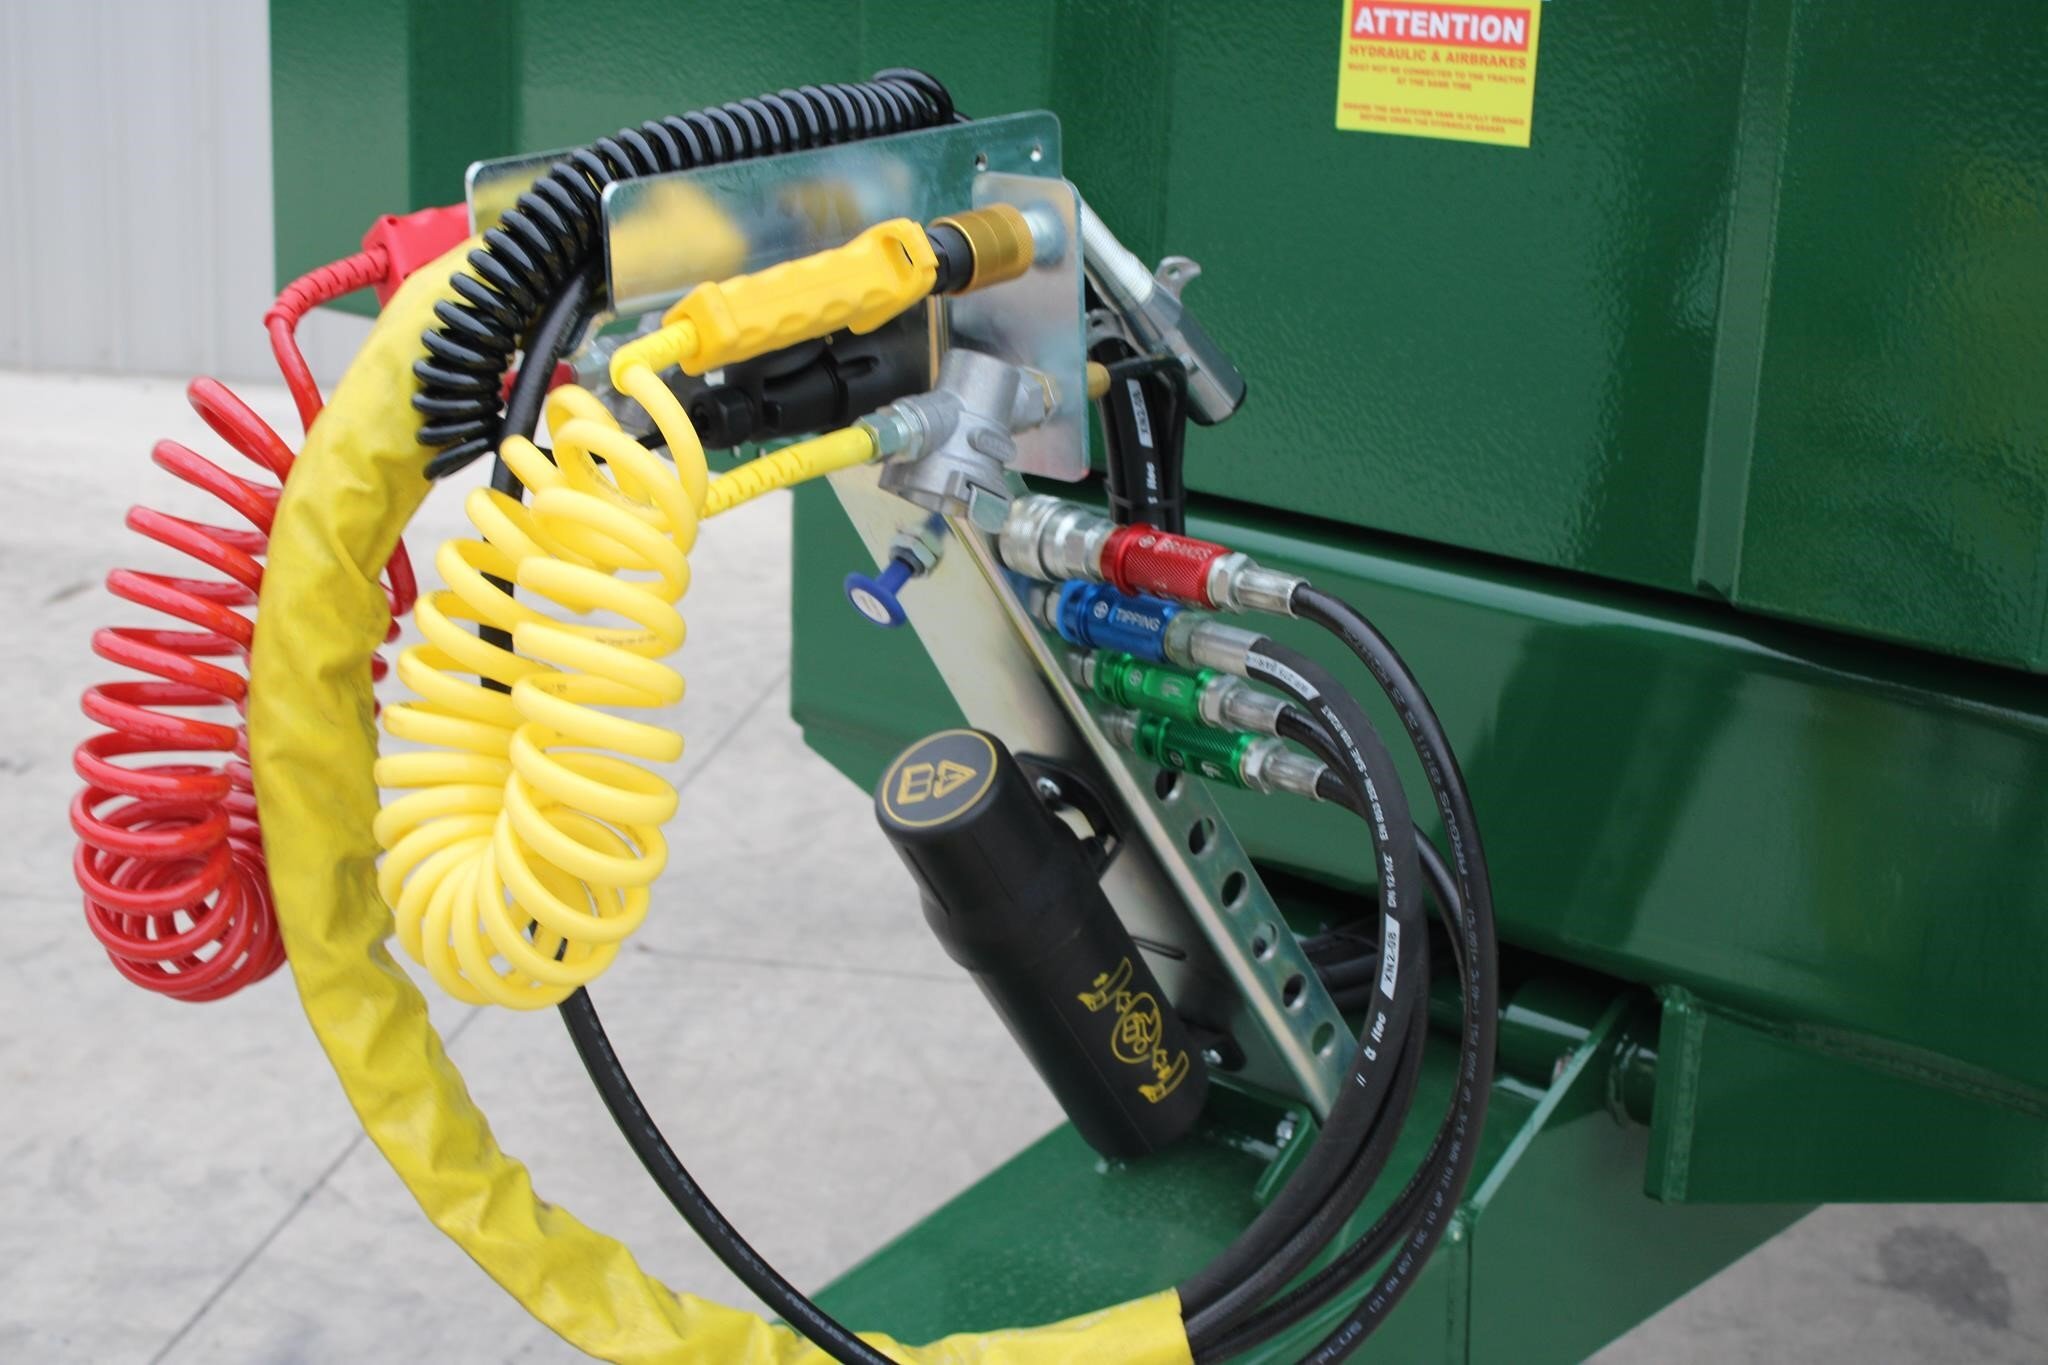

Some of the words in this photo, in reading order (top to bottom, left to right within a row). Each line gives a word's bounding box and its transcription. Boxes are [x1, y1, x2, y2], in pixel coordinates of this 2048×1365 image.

[1354, 6, 1525, 45] ATTENTION
[1349, 45, 1427, 62] HYDRAULIC
[1431, 52, 1440, 63] &
[1446, 52, 1527, 69] AIRBRAKES
[1116, 607, 1160, 632] TIPPING
[1439, 791, 1468, 875] ARGUS
